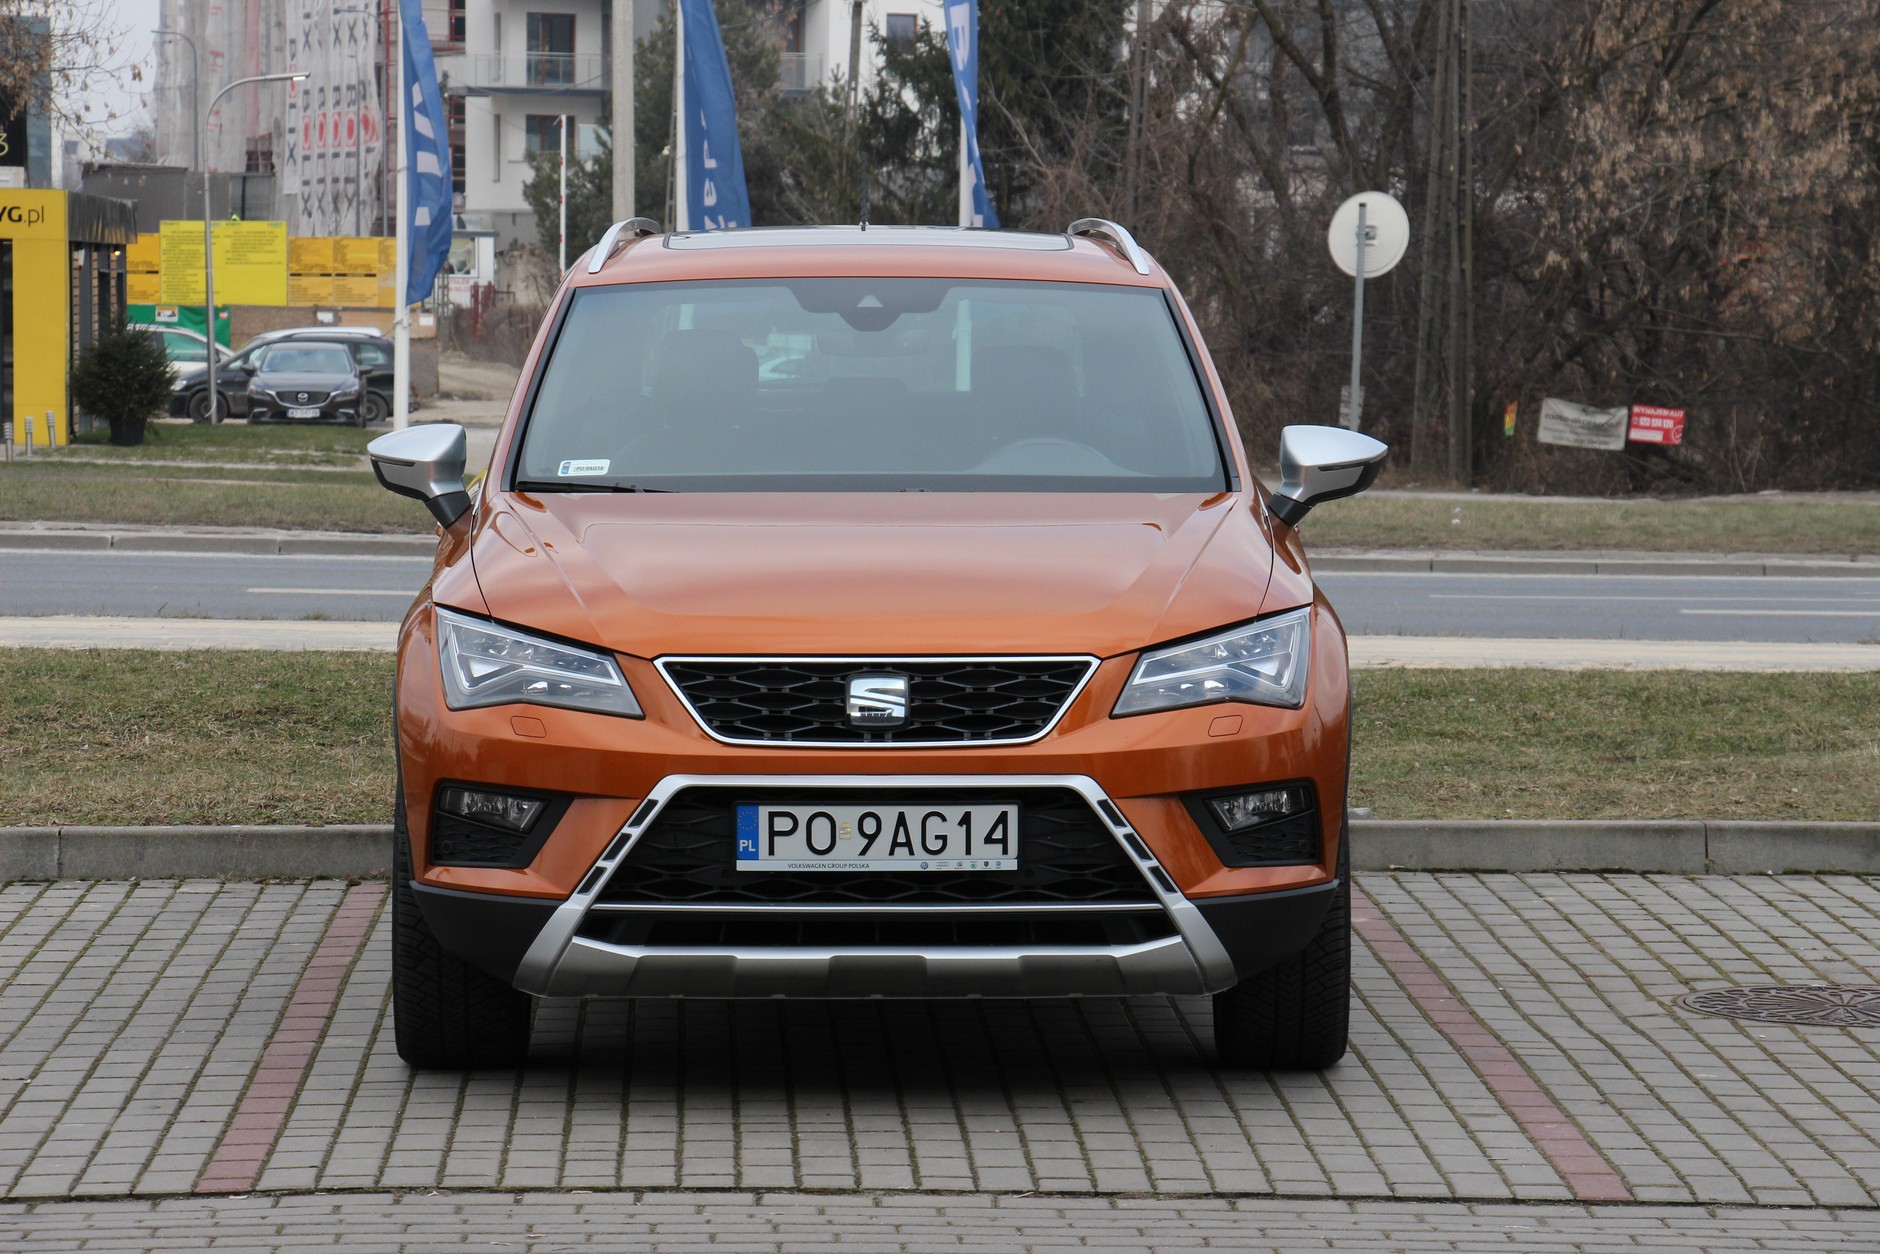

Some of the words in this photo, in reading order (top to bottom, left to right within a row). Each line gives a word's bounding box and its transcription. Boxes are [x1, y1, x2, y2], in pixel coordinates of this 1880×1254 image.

[739, 839, 756, 851] PL
[767, 810, 837, 856] PO
[857, 810, 1009, 856] 9AG14
